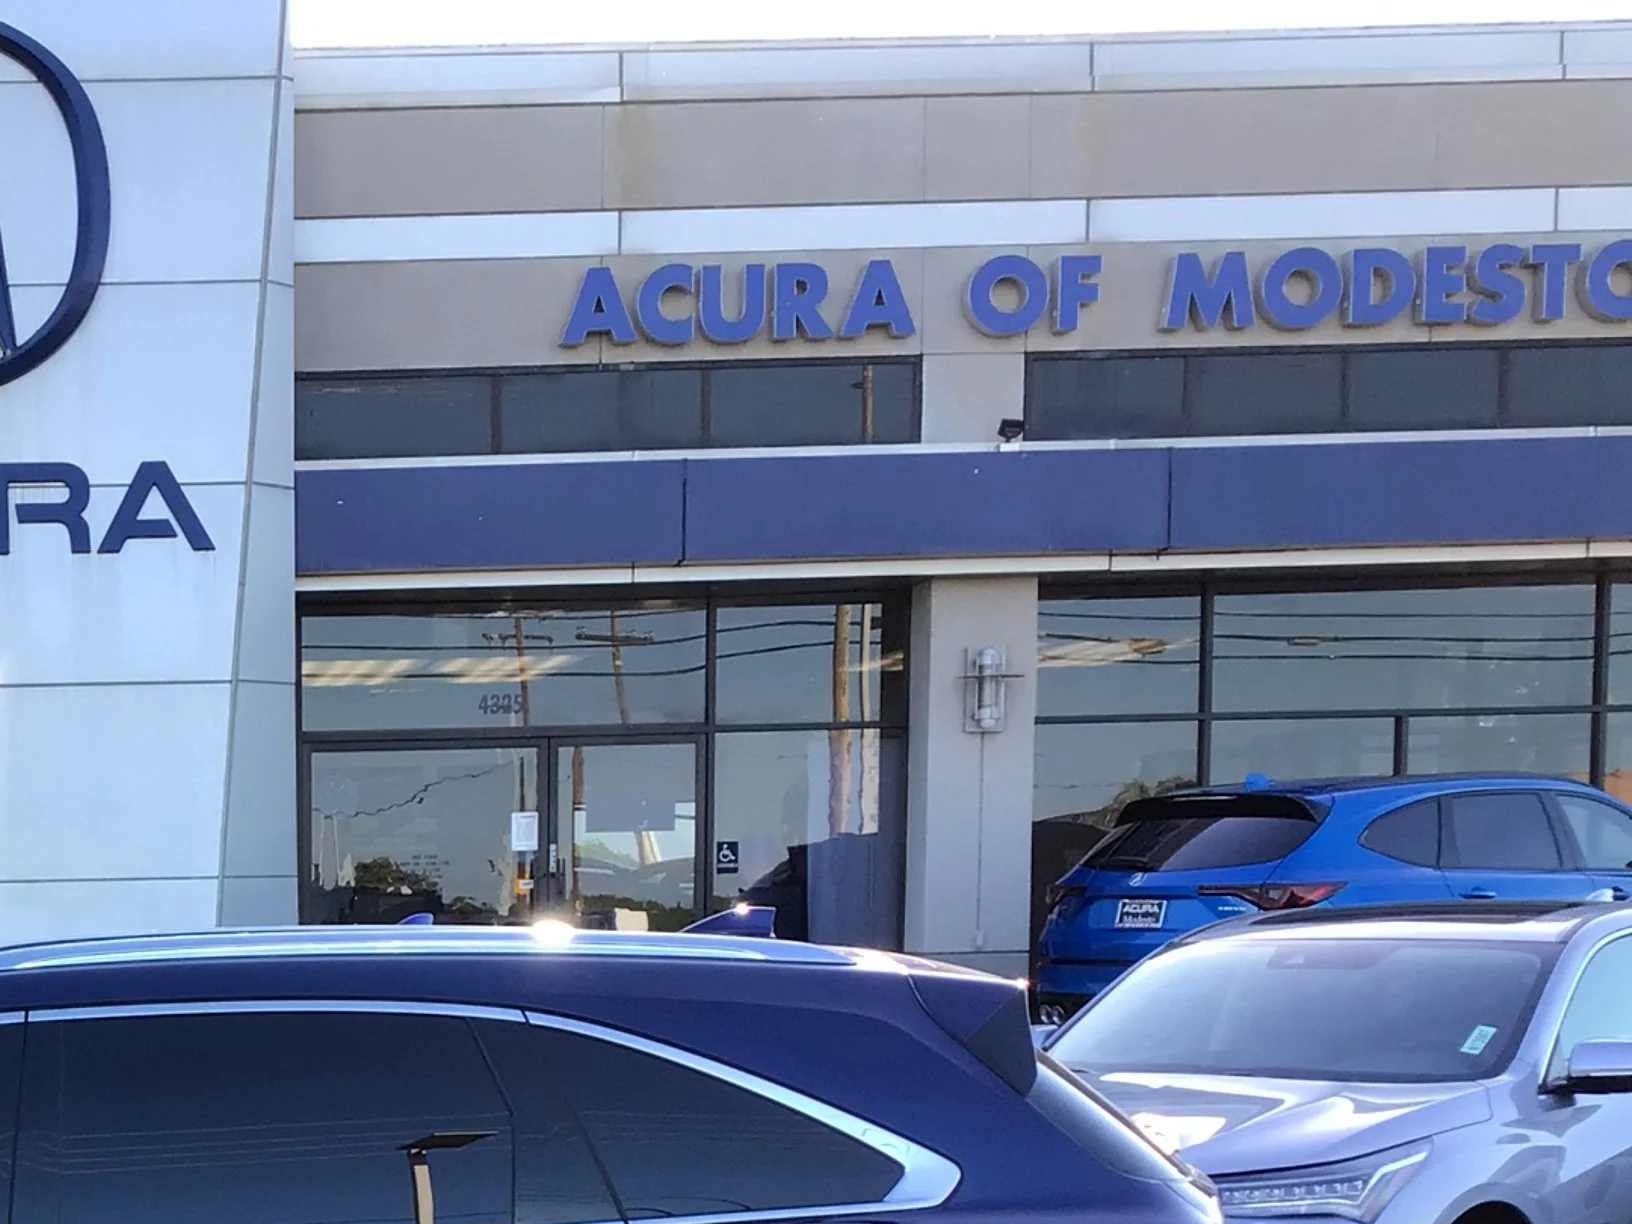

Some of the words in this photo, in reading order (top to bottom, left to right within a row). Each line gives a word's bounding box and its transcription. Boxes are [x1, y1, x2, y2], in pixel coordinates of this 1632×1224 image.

[559, 259, 916, 347] ACURA
[966, 254, 1103, 336] OF
[1122, 903, 1160, 913] ACURA
